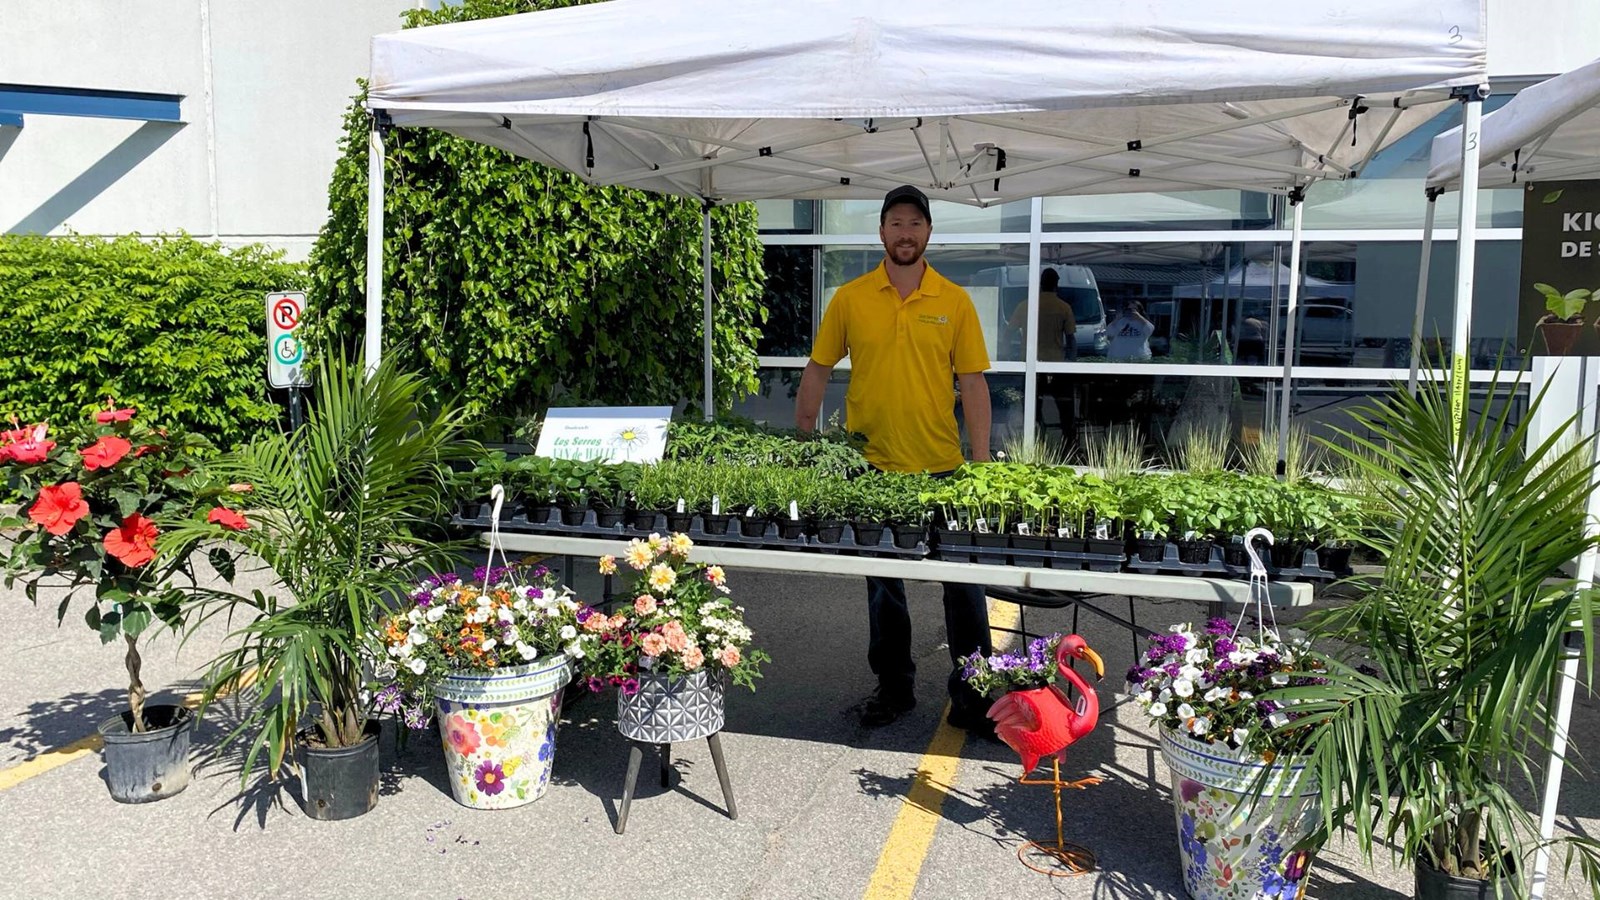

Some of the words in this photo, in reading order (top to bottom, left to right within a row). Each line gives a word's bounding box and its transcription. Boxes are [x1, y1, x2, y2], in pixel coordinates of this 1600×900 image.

[1448, 25, 1463, 45] 3
[1466, 132, 1478, 151] 3
[1561, 241, 1592, 258] DE
[554, 436, 570, 447] Les
[572, 436, 603, 447] Serres
[572, 447, 583, 460] de
